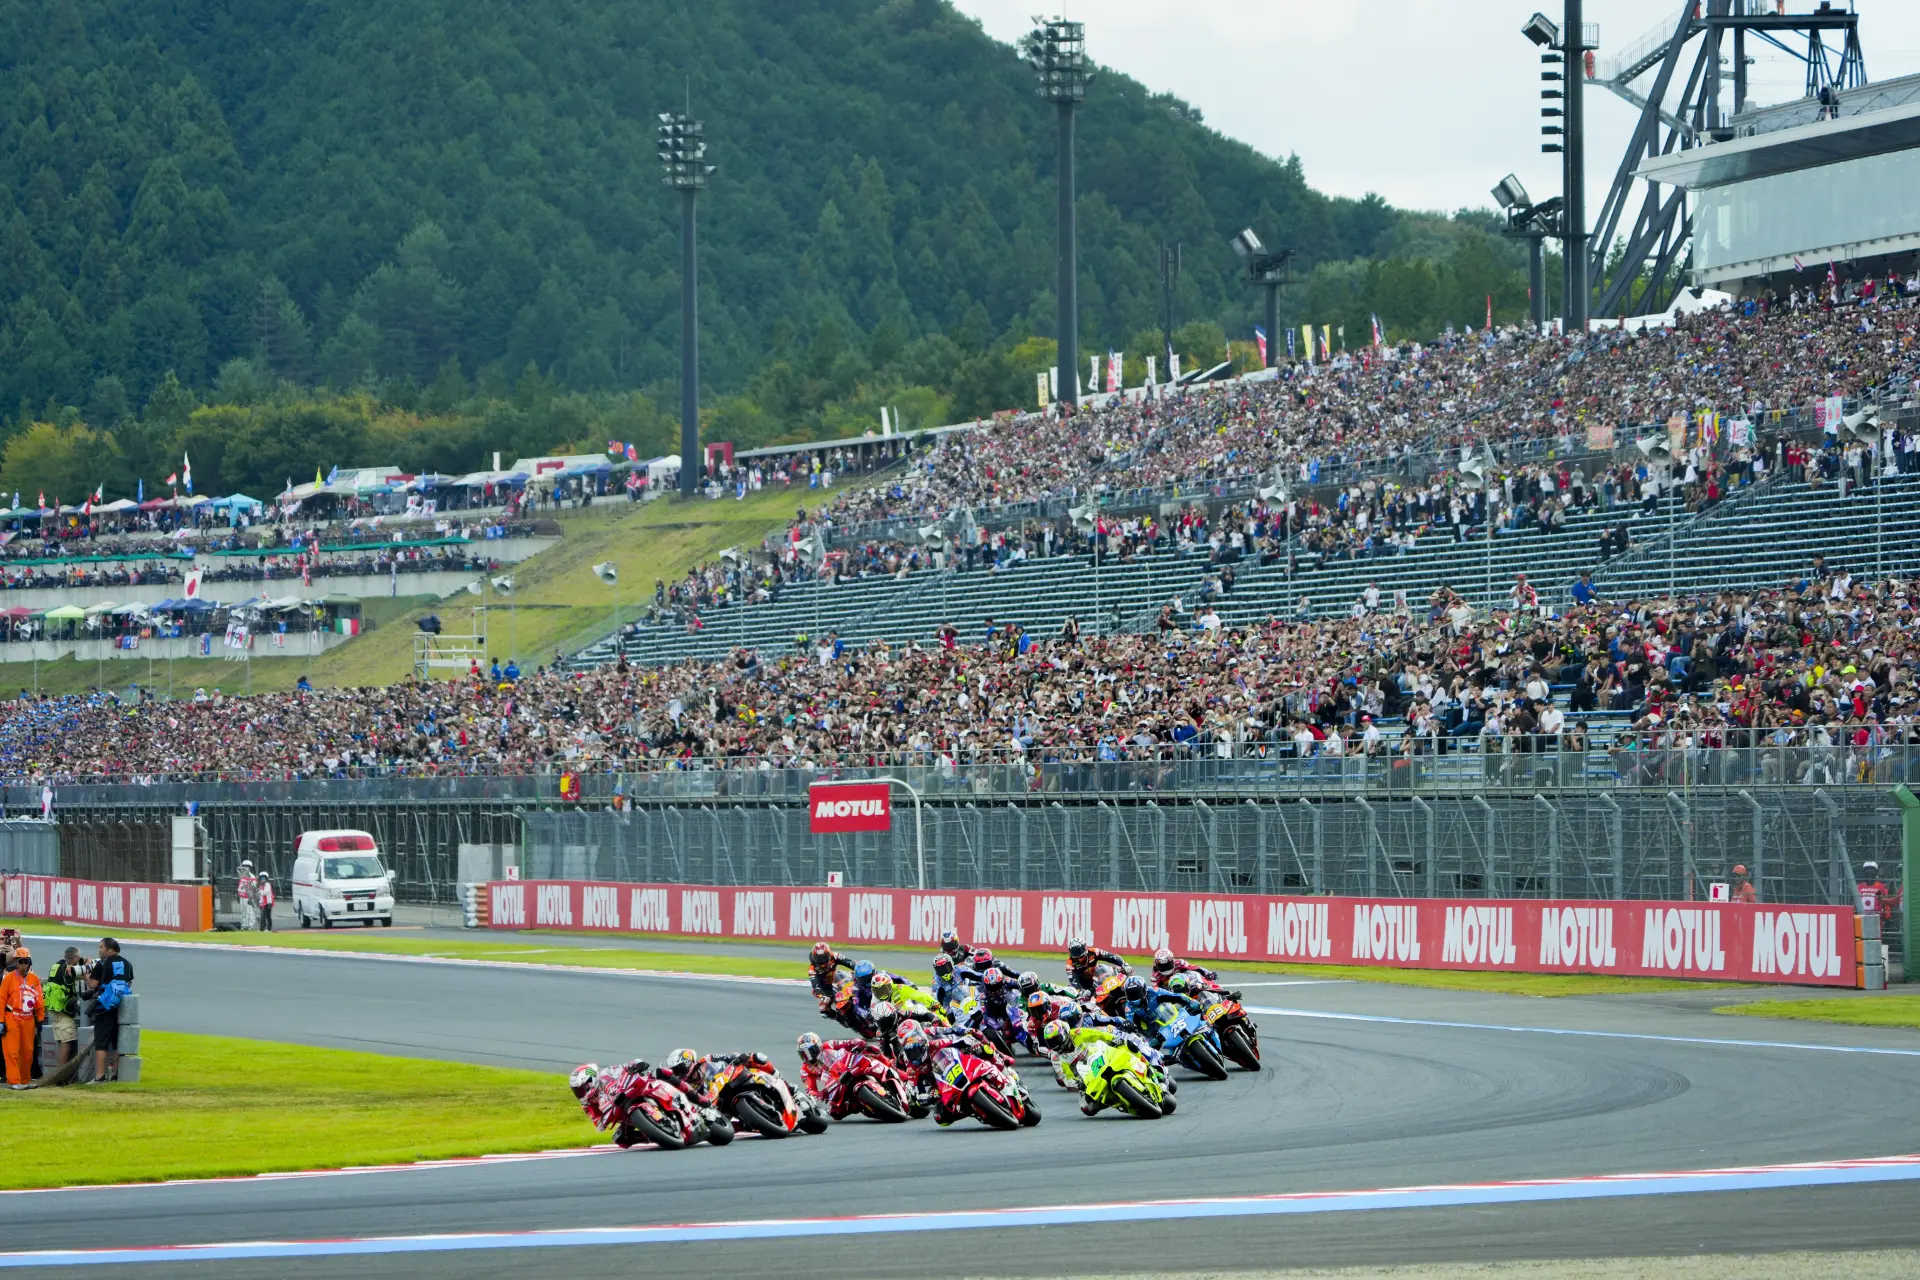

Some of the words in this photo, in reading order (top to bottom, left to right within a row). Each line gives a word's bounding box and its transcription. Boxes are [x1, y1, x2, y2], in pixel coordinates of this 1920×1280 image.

[815, 800, 884, 818] MOTUL
[492, 885, 525, 924] MOTUL
[537, 885, 572, 925] MOTUL
[583, 886, 619, 928] MOTUL
[631, 888, 669, 931] MOTUL
[682, 890, 721, 934] MOTUL
[733, 891, 776, 936] MOTUL
[789, 892, 834, 938] MOTUL
[848, 893, 895, 940] MOTUL
[909, 895, 957, 942] MOTUL
[973, 896, 1025, 946] MOTUL
[1040, 896, 1094, 947] MOTUL
[1112, 898, 1168, 951] MOTUL
[1187, 900, 1247, 954] MOTUL
[1267, 902, 1331, 957] MOTUL
[1352, 904, 1420, 961] MOTUL
[1442, 906, 1516, 964] MOTUL
[1540, 907, 1616, 967] MOTUL
[1641, 908, 1725, 971] MOTUL
[1751, 912, 1841, 977] MOTUL
[1105, 979, 1118, 990] 23
[1171, 1019, 1188, 1038] 25
[945, 1063, 963, 1087] 36
